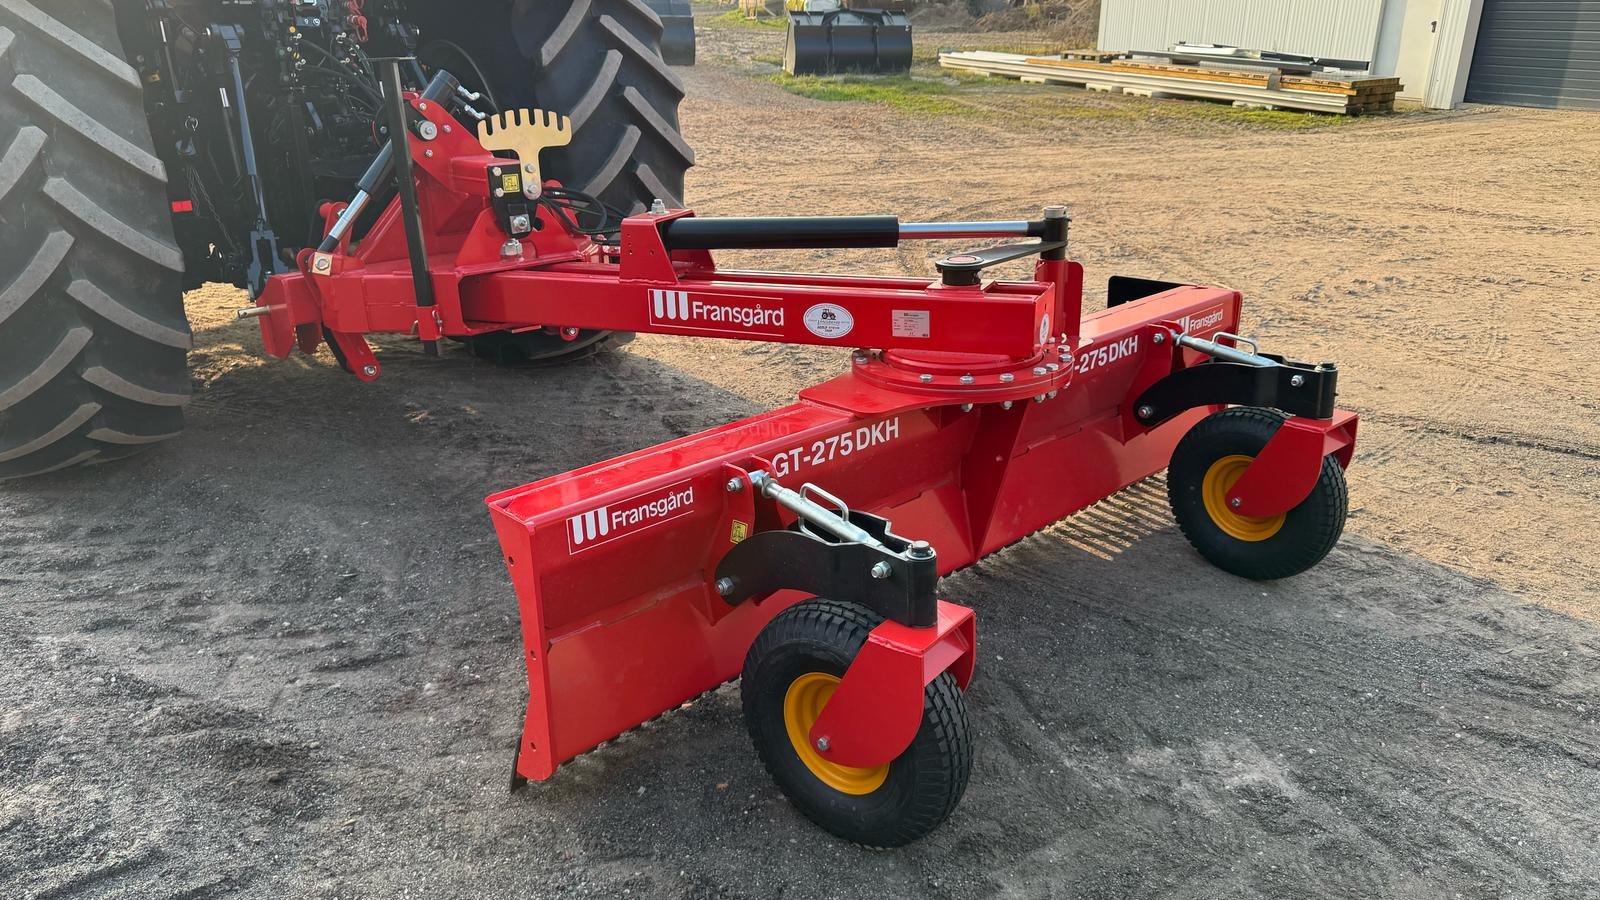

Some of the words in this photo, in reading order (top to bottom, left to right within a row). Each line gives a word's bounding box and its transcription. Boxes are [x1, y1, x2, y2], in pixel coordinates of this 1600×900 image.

[692, 301, 784, 327] Fransgård
[1190, 309, 1223, 331] Fransgård
[611, 486, 694, 529] Fransgård
